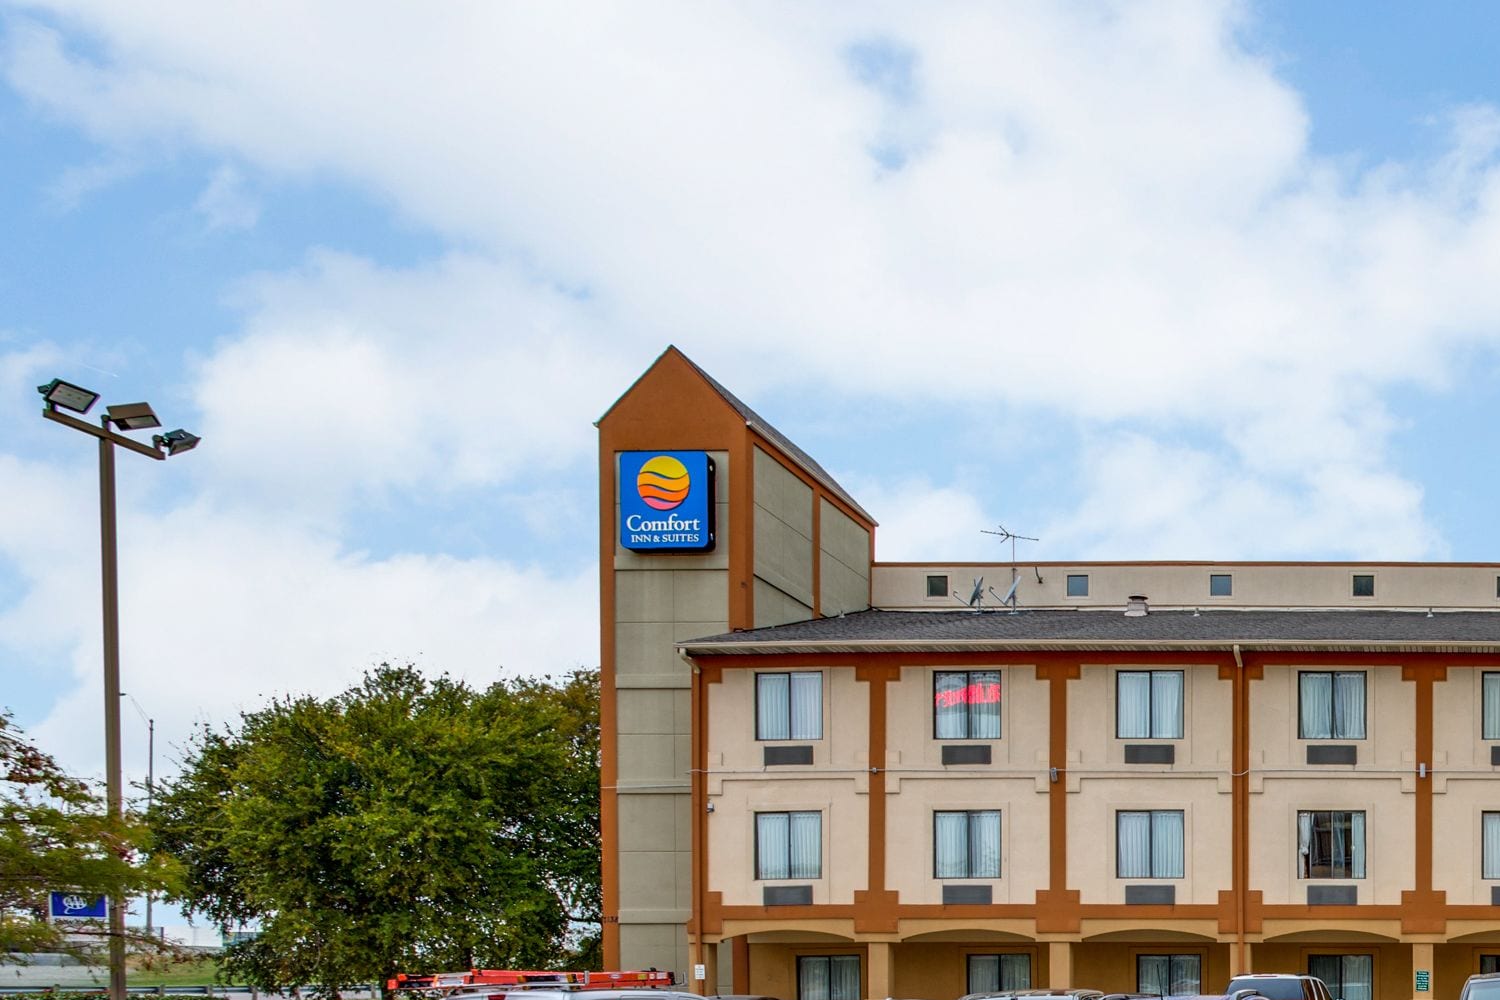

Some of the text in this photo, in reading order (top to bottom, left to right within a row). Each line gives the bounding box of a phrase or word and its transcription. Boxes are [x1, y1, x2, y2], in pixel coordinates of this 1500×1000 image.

[626, 513, 700, 532] Comfort
[631, 533, 699, 543] INN & SUITES
